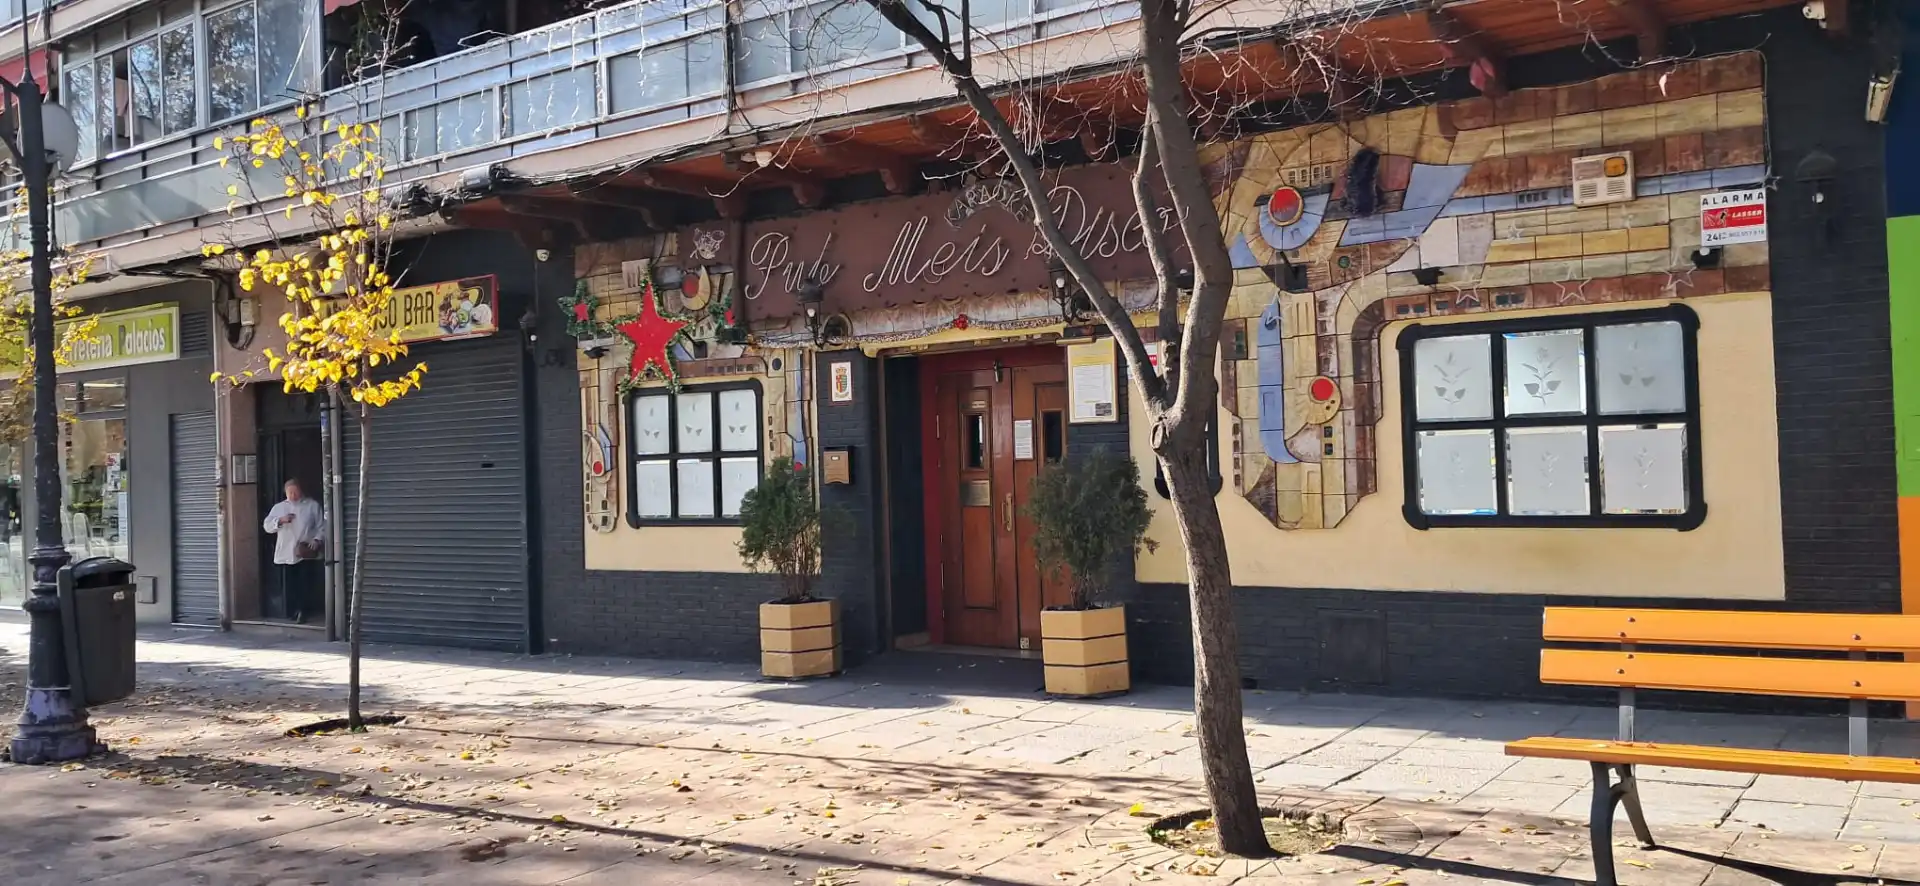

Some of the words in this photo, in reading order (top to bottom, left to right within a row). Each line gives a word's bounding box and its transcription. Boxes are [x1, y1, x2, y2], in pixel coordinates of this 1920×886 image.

[944, 184, 1029, 231] KARAOKE
[1702, 191, 1765, 206] ALARMA
[745, 232, 840, 300] Pub
[863, 215, 1010, 292] Meis
[1047, 185, 1163, 260] Disc
[404, 291, 435, 327] BAR
[118, 317, 167, 356] Palacios
